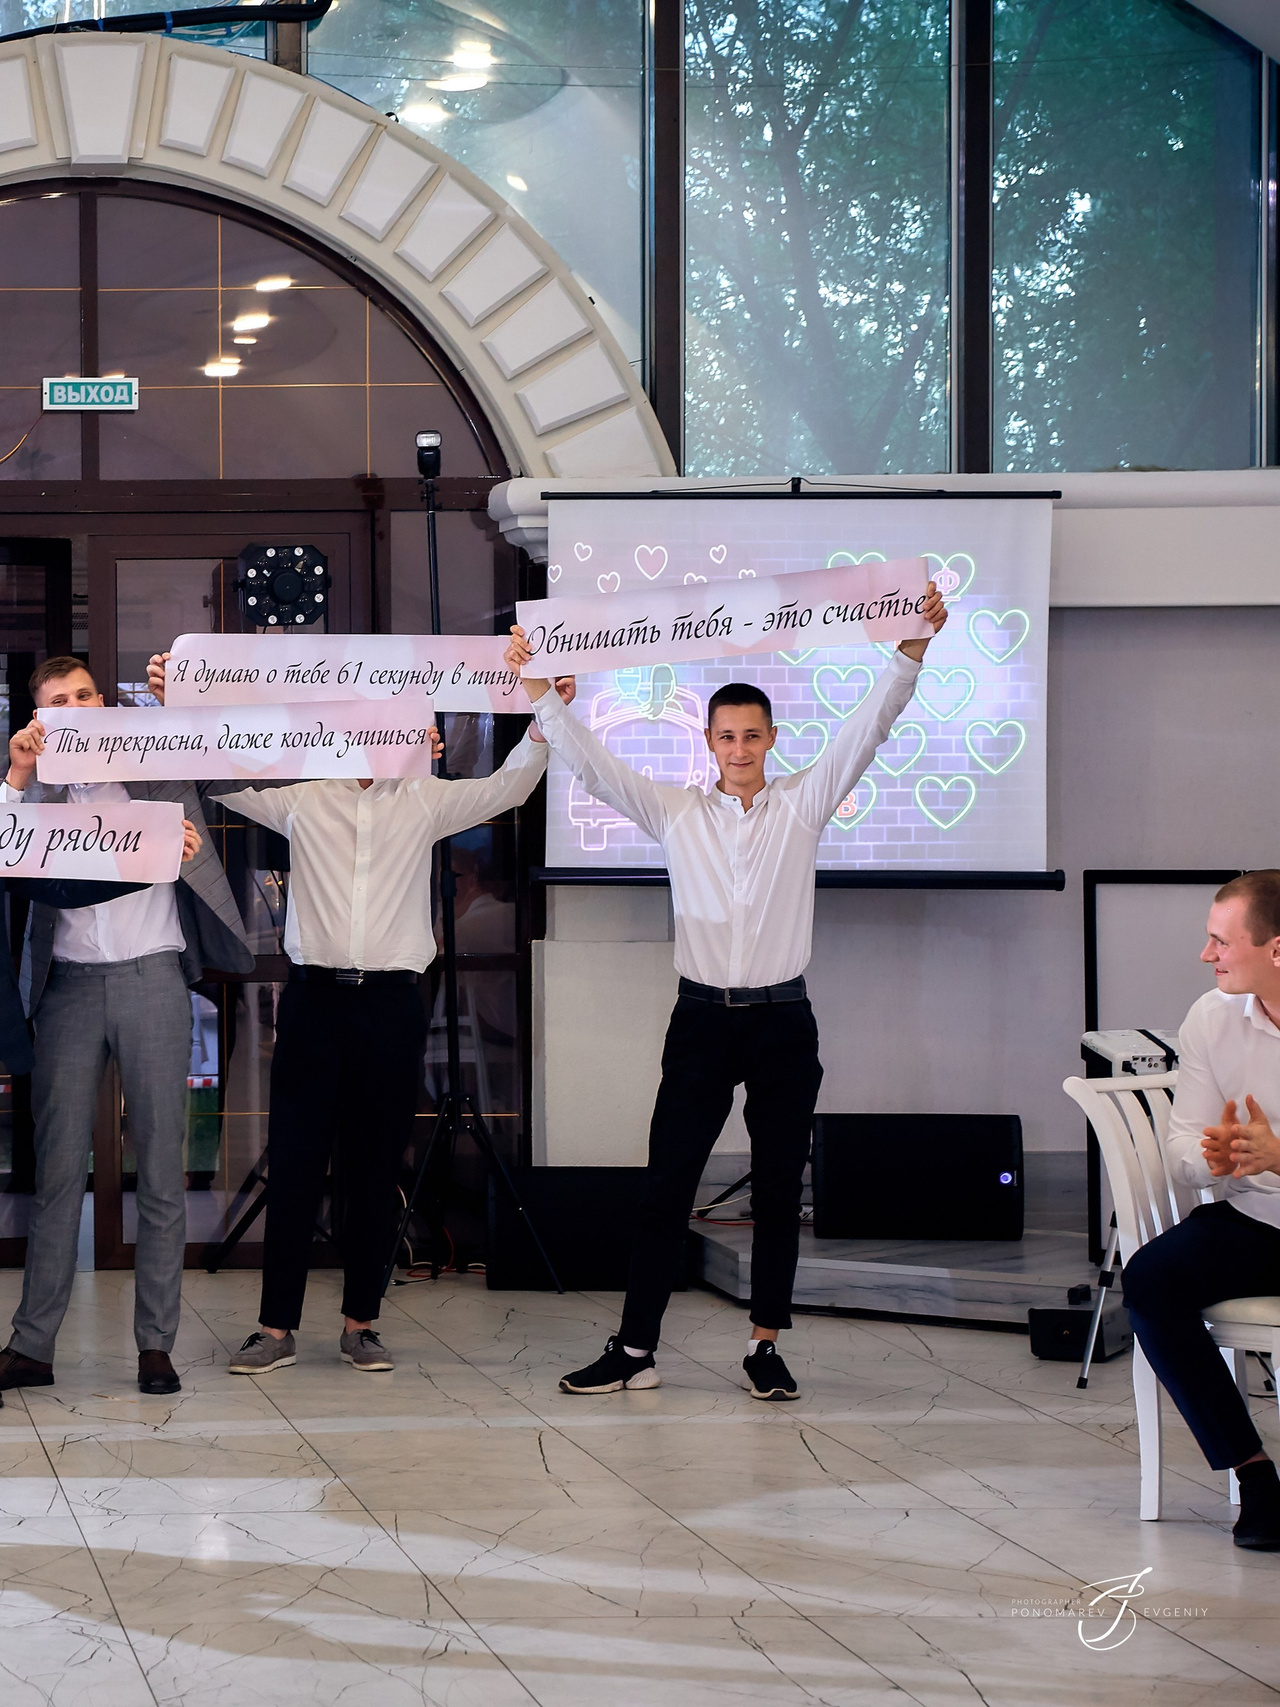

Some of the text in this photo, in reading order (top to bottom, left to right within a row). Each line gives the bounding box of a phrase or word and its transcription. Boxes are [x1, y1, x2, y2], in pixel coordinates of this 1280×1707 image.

[53, 385, 130, 403] ВЫХОД
[527, 615, 662, 656] Обнимать
[671, 604, 733, 642] тебя
[762, 600, 812, 631] это
[822, 588, 926, 624] счастье
[173, 659, 522, 696] Я думаю о тебе 61 секунду в мину
[44, 721, 427, 764] Ты прекрасна, даже когда злишься
[40, 815, 143, 869] рядом
